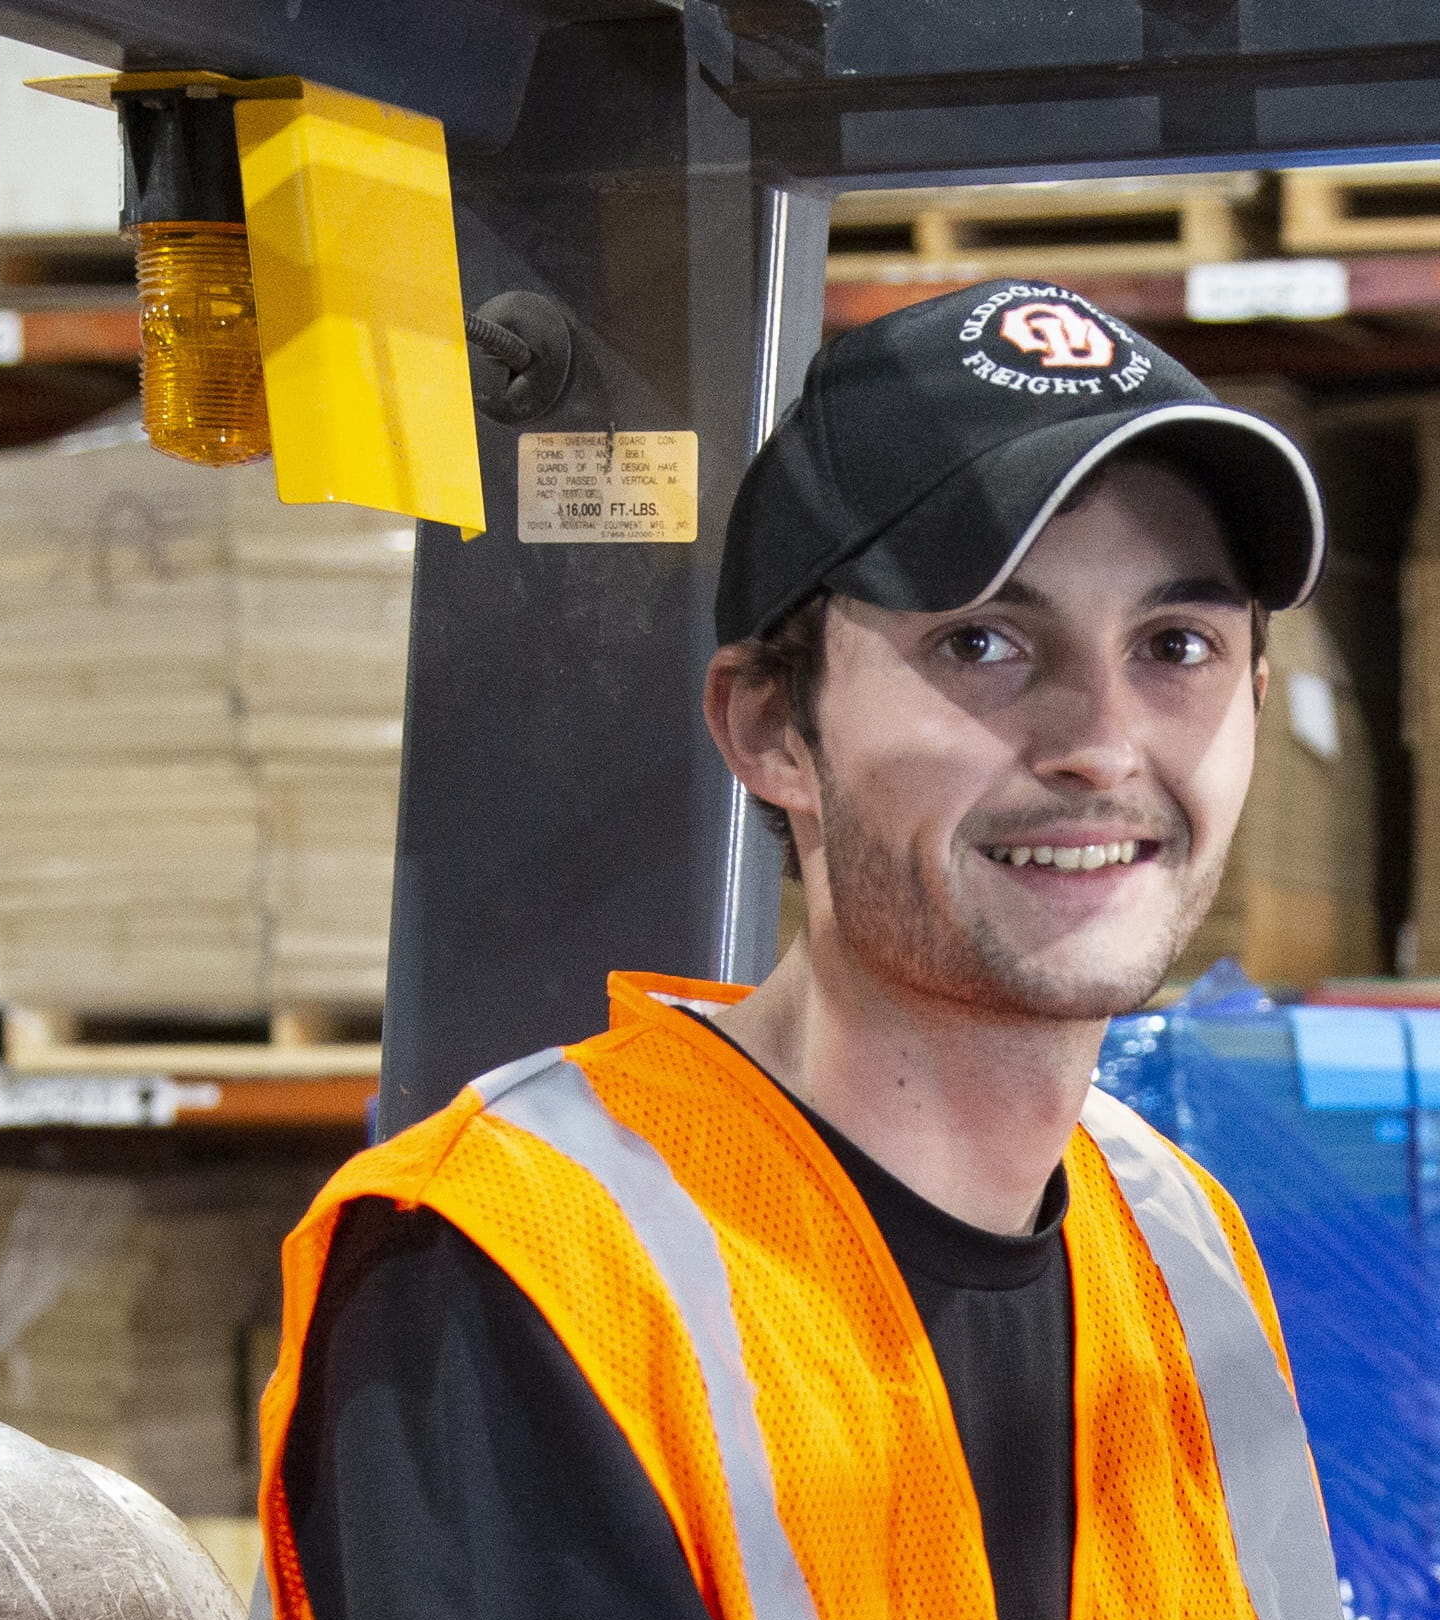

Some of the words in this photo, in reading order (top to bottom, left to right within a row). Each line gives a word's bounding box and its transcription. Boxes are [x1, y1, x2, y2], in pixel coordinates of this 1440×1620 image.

[959, 303, 999, 342] OLD
[962, 350, 1103, 395] FREIGHT
[1110, 350, 1153, 393] LINE
[618, 436, 647, 446] GUARD
[536, 450, 564, 460] FORMS
[574, 450, 585, 460] TO
[595, 450, 613, 460] ANS
[535, 463, 569, 473] GUARDS
[576, 463, 588, 473] OF
[620, 463, 650, 473] DESIGN
[658, 463, 679, 472] HAVE
[536, 477, 558, 487] ALSO
[565, 477, 597, 486] PASSED
[621, 476, 659, 486] VERTICAL
[565, 502, 602, 518] 16,000
[610, 502, 660, 517] FT.-LBS.
